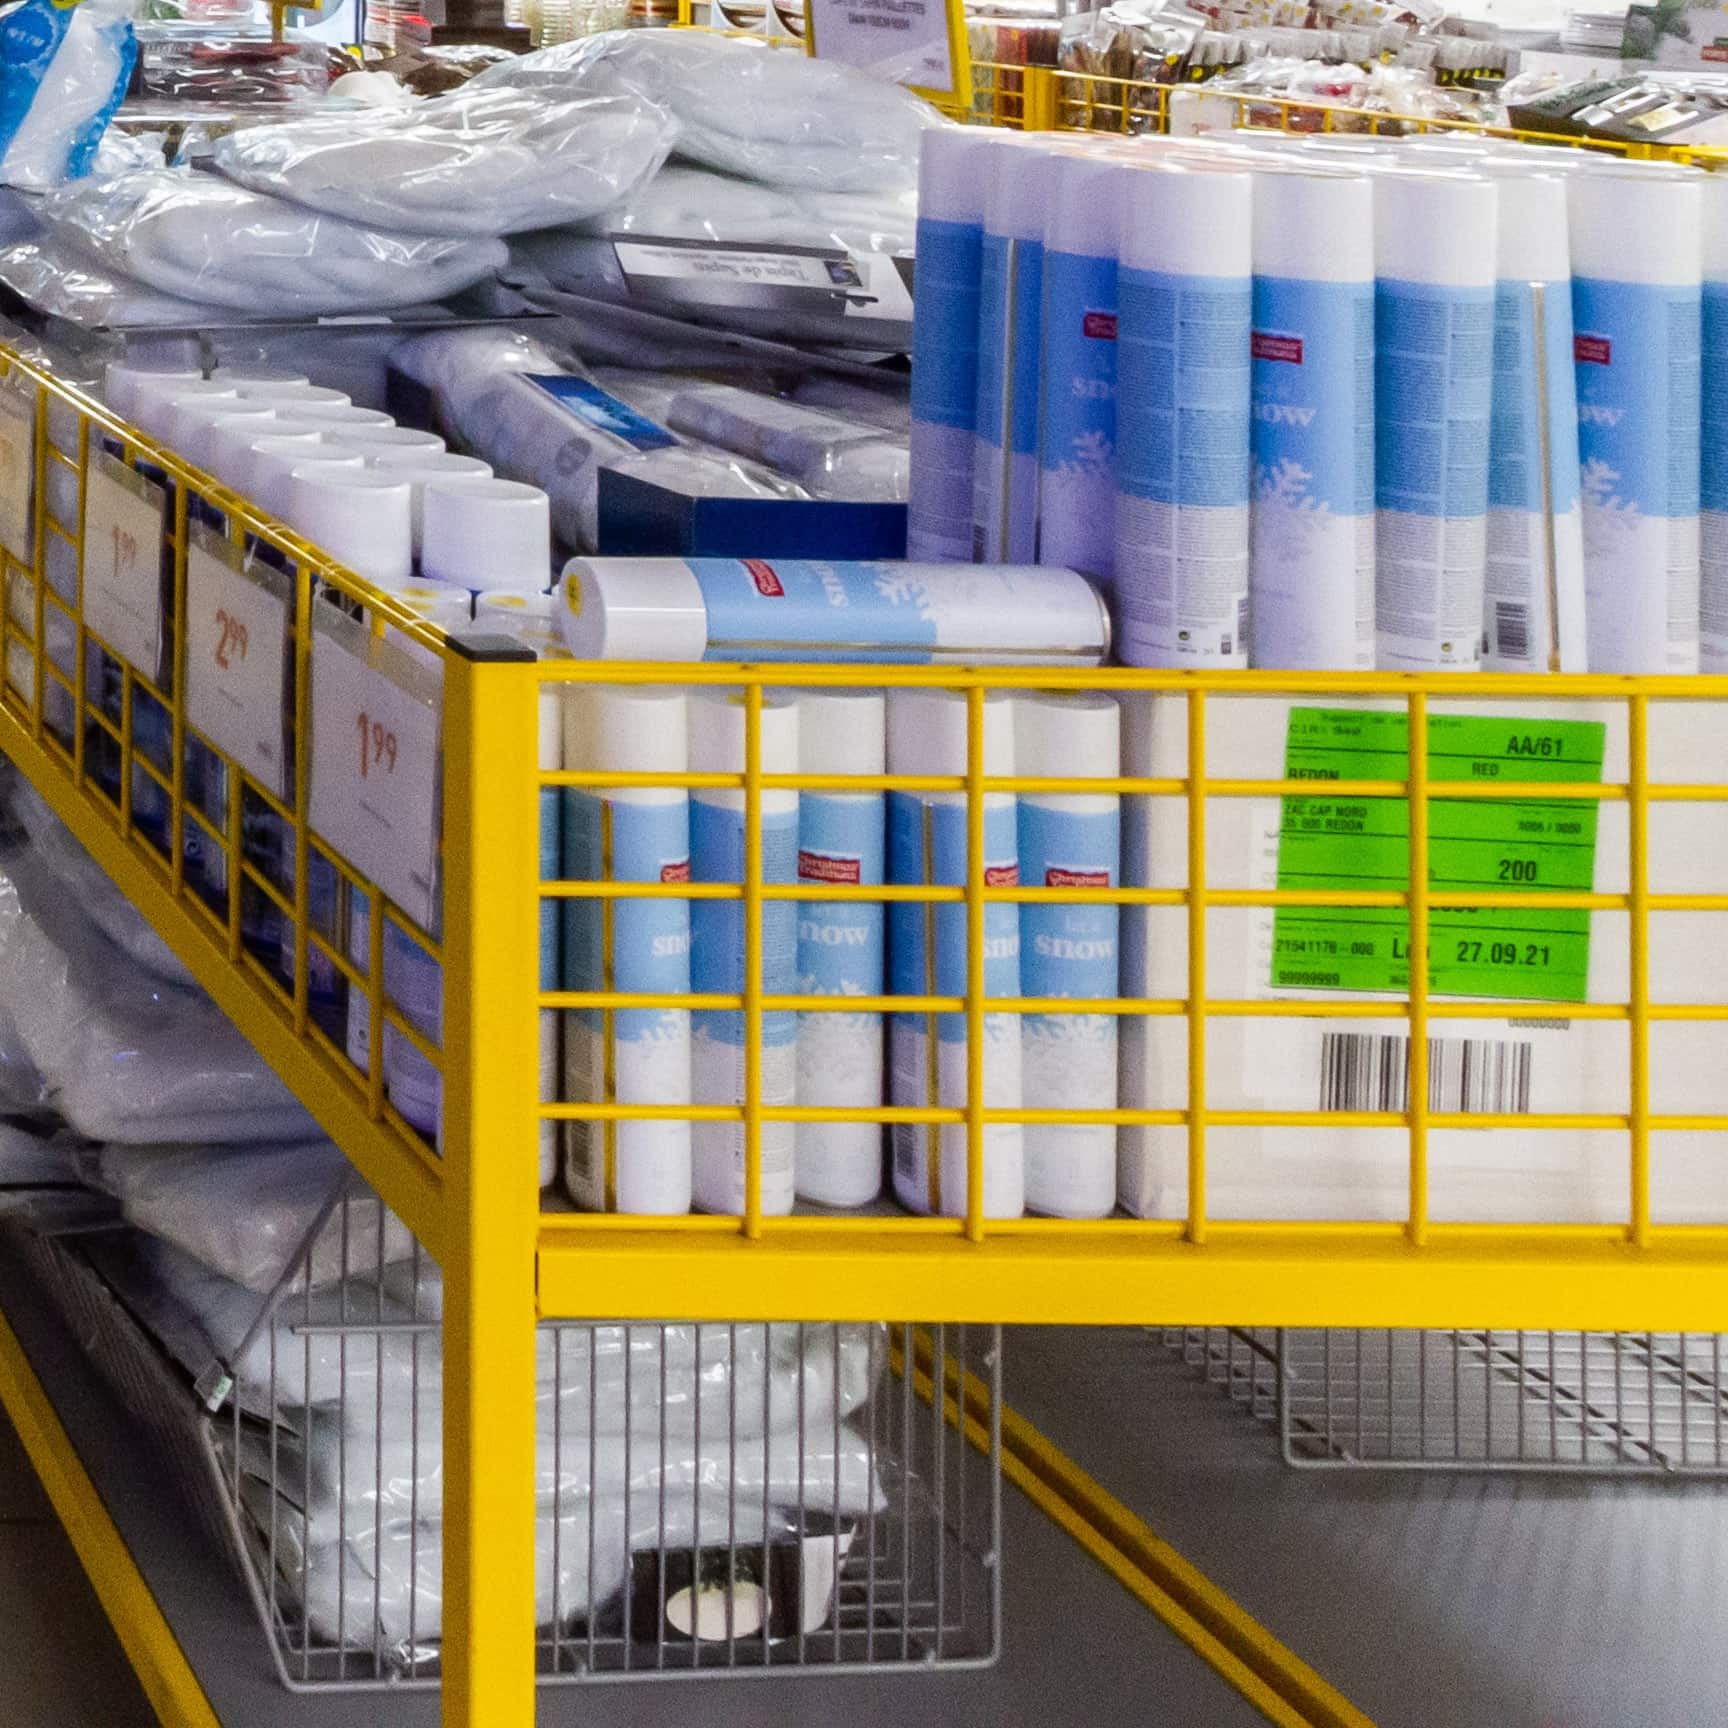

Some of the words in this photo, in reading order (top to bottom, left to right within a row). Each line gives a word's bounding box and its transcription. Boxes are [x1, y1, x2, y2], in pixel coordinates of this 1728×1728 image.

[1506, 735, 1564, 757] AA/61
[1471, 762, 1500, 777] RED
[1498, 858, 1538, 882] 200
[800, 922, 869, 947] now
[1036, 932, 1114, 961] snow
[1456, 940, 1550, 967] 27.09.21
